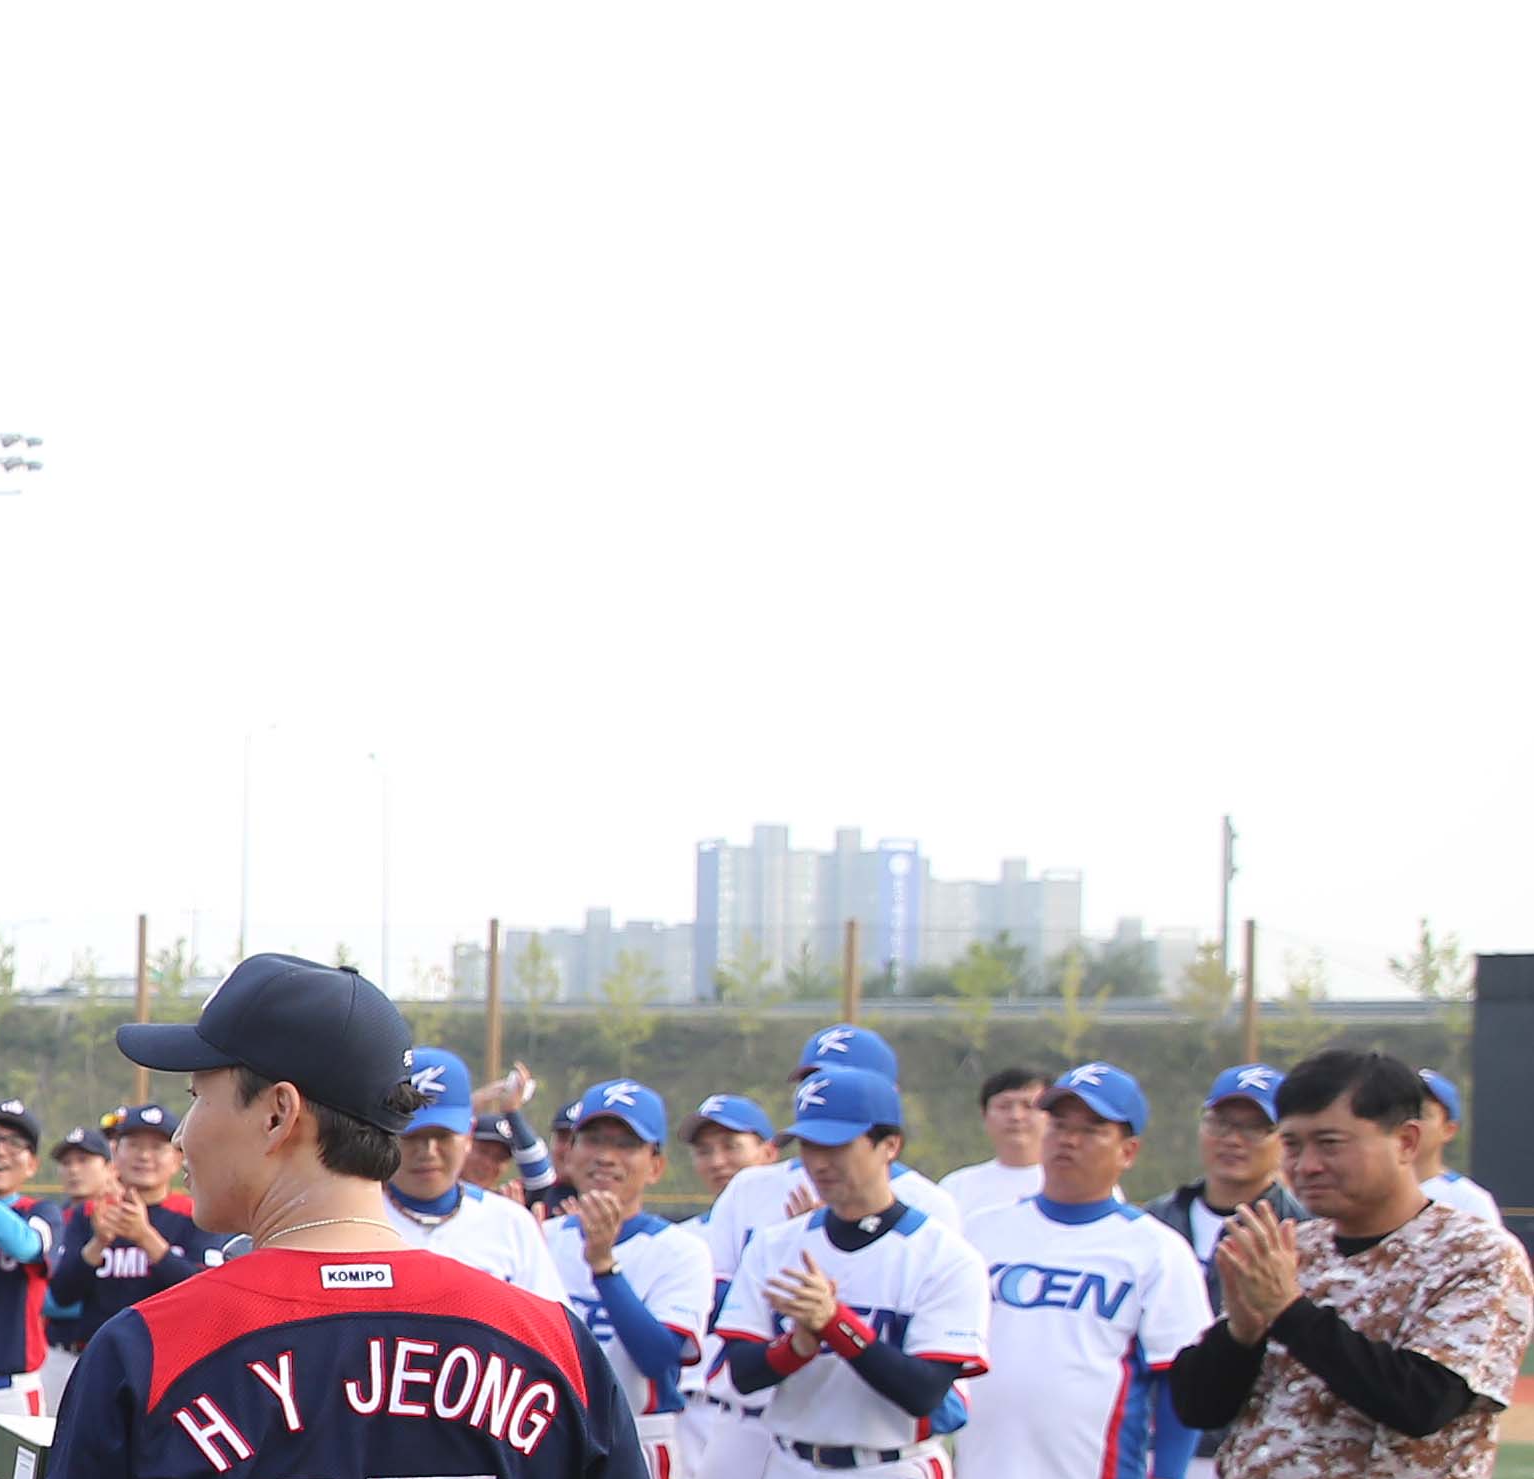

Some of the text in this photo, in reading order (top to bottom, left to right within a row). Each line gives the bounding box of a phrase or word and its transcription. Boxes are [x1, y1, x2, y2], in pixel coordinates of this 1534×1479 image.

[327, 1269, 386, 1284] KOMIPO
[173, 1337, 559, 1473] H Y JEONG
